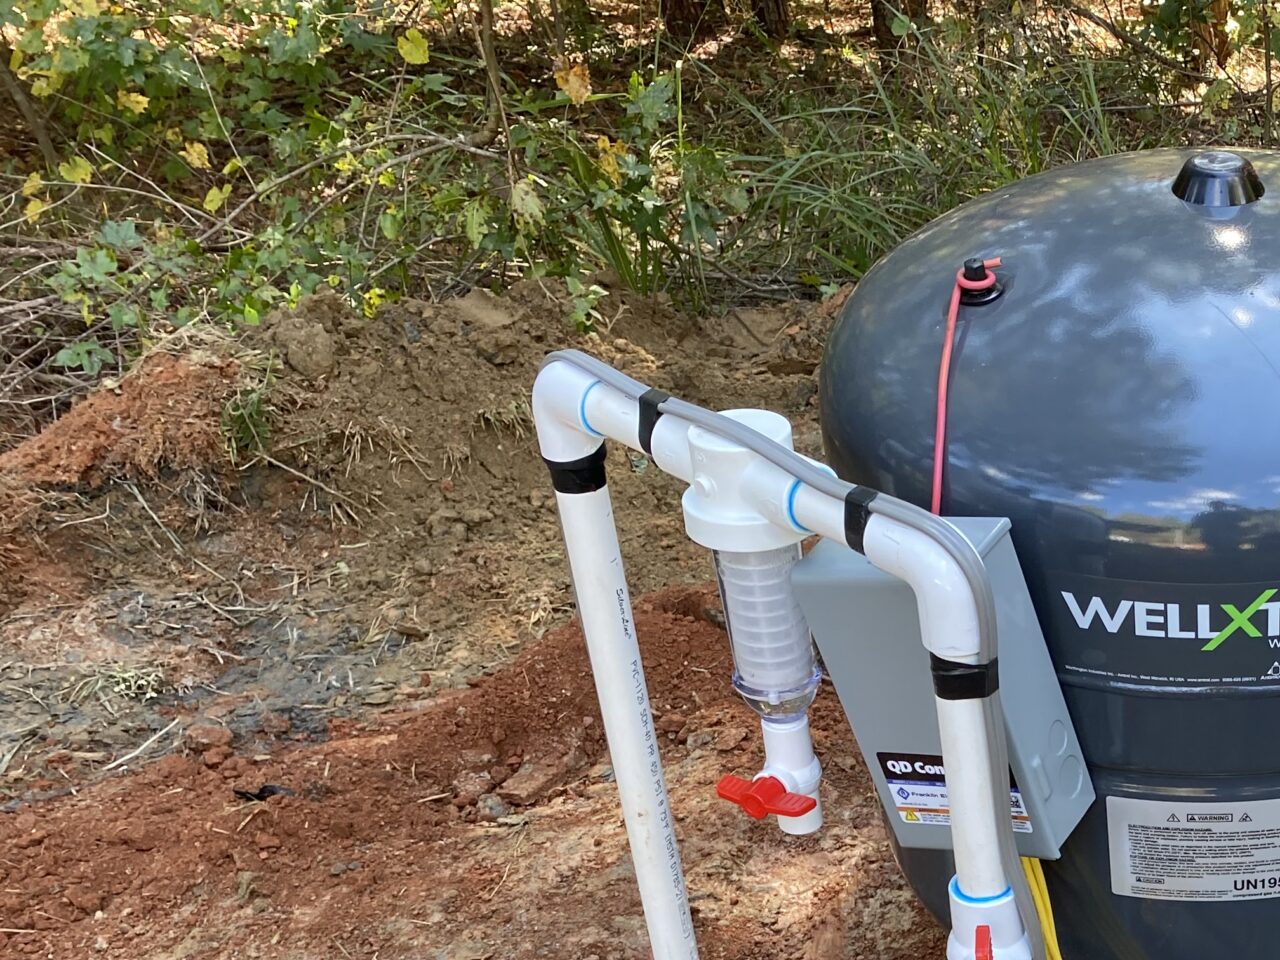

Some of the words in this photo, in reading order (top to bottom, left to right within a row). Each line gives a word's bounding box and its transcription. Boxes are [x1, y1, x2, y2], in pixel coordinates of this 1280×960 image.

[616, 588, 632, 639] Silver-Line
[630, 660, 644, 705] PVC-1120
[639, 710, 651, 741] SCH-40
[648, 744, 656, 758] PR
[654, 779, 663, 797] PSI
[886, 760, 912, 775] QD
